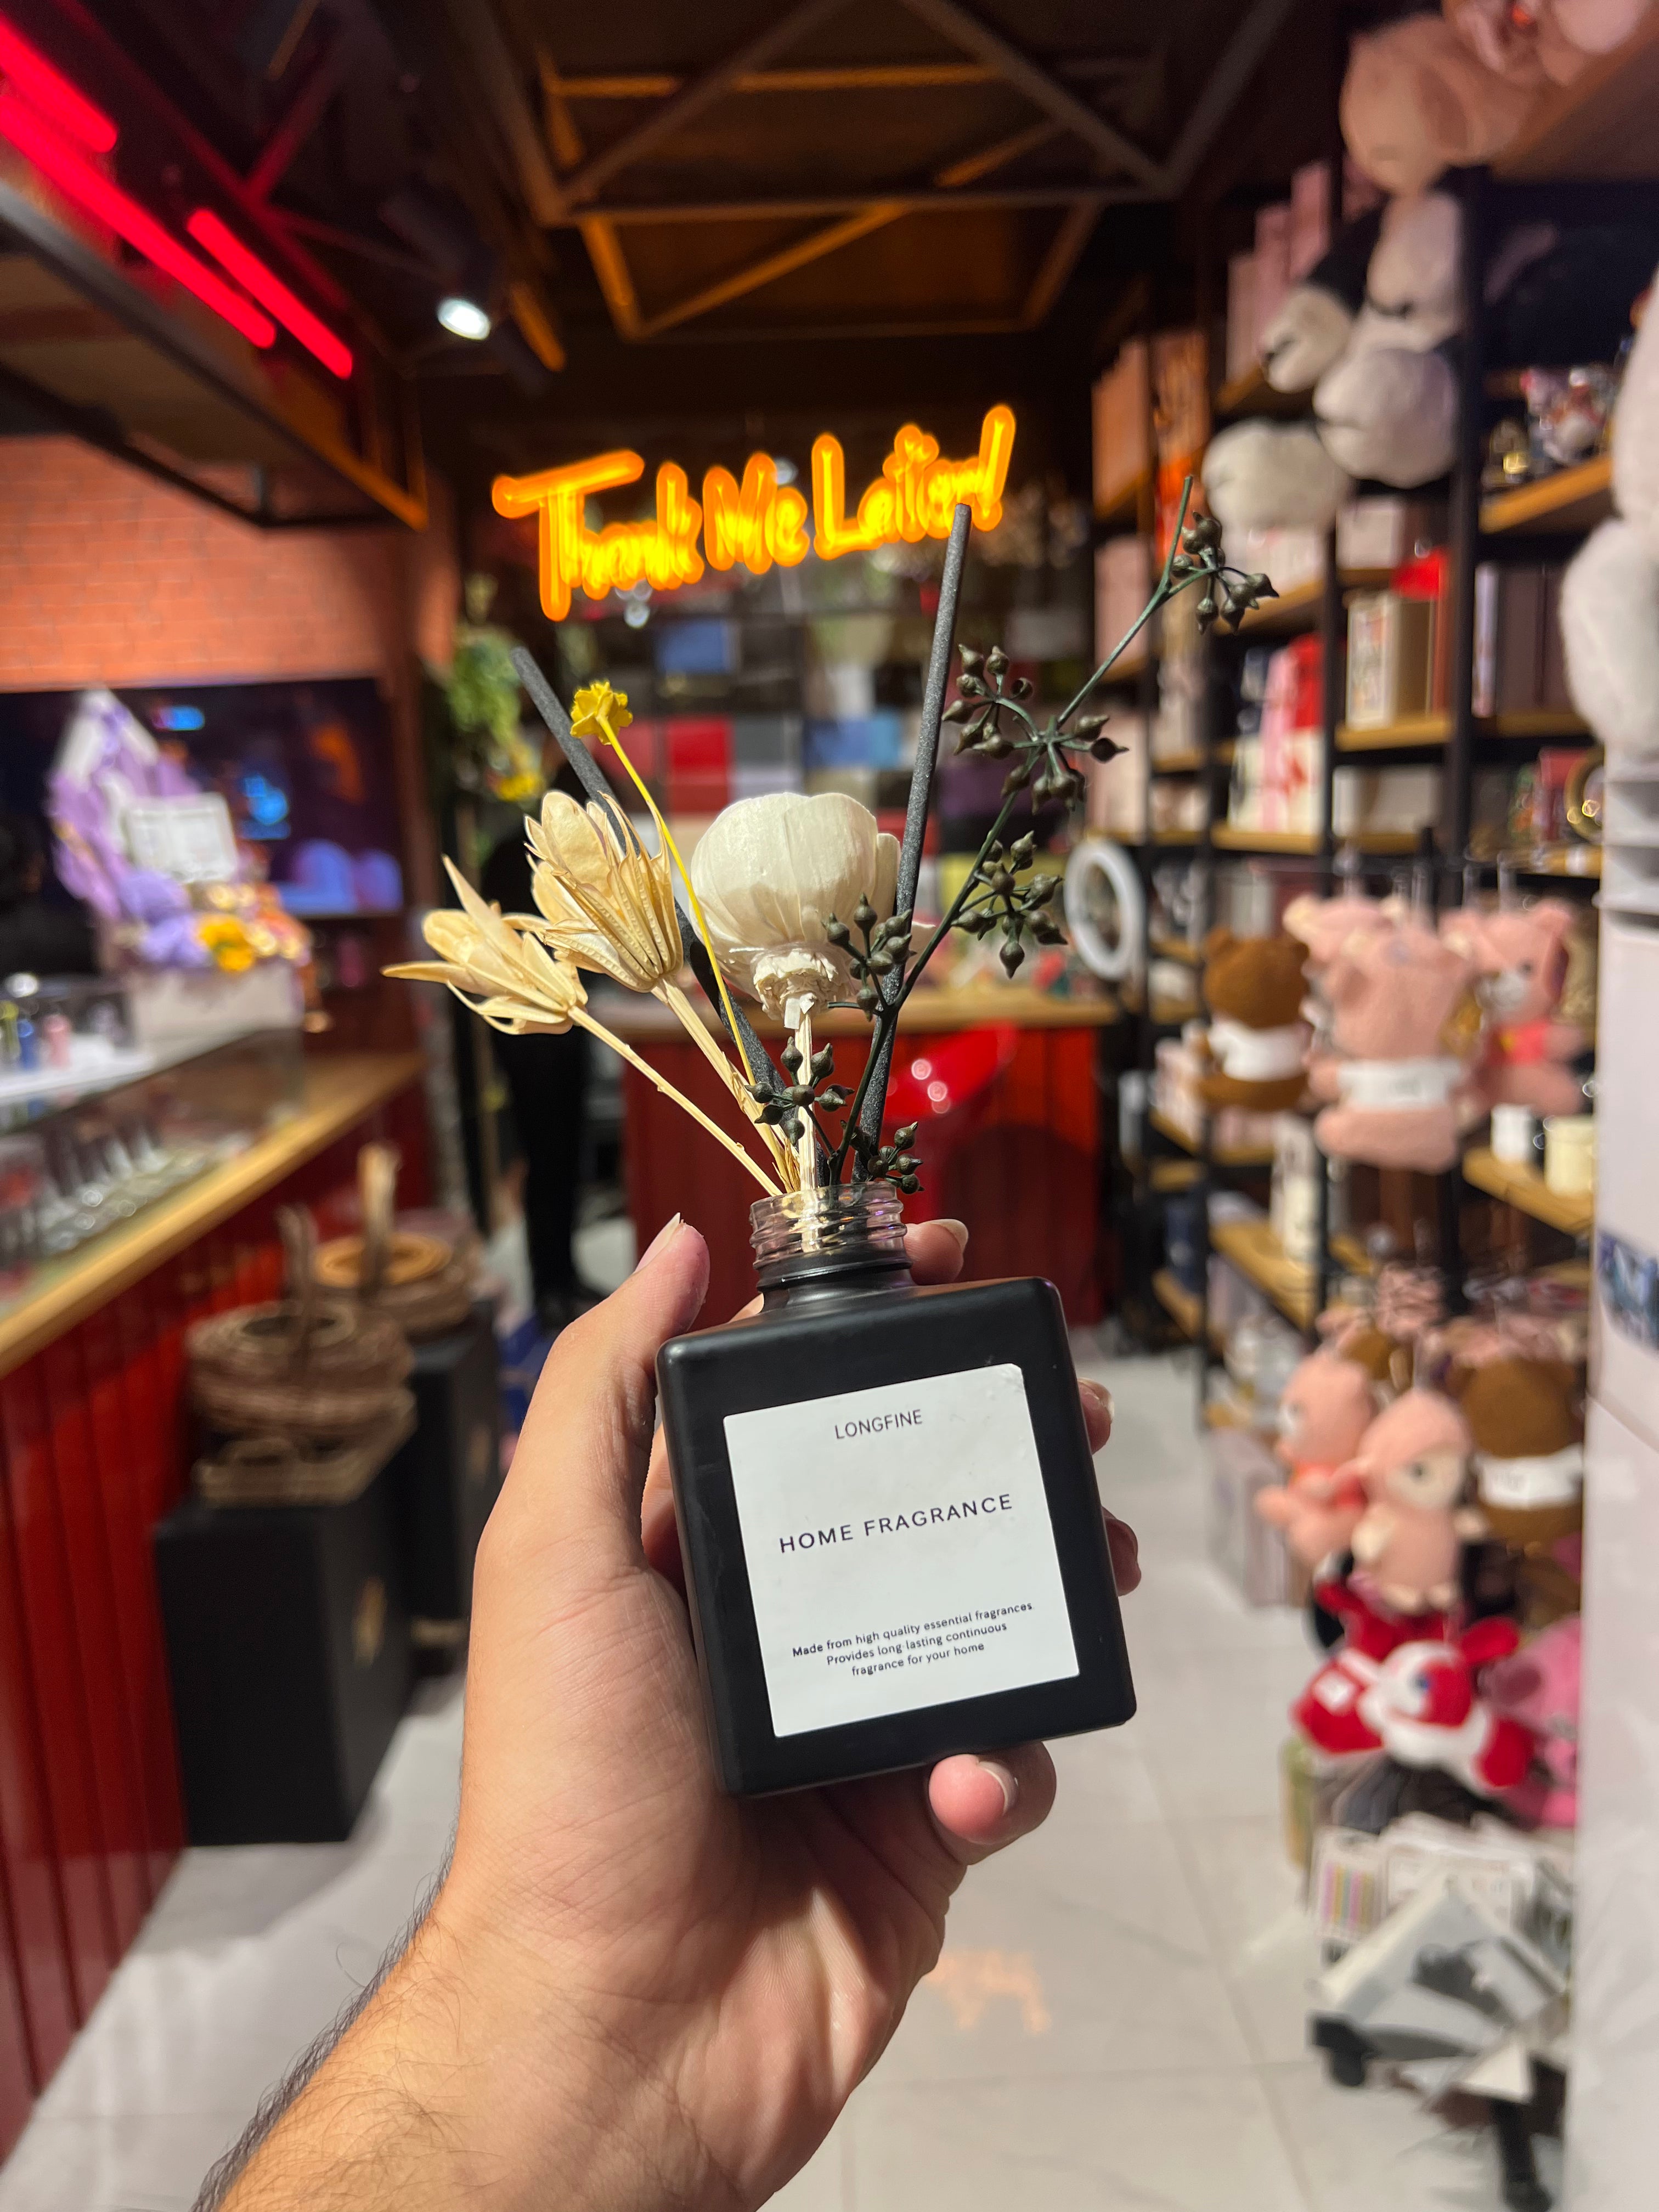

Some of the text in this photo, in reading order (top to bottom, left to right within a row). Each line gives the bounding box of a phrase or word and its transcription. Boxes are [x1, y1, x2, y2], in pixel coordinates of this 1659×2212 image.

[703, 452, 809, 574] Me
[834, 1409, 923, 1440] LONGFINE
[779, 1493, 1013, 1554] HOME FRAGRANCE
[792, 1602, 1032, 1658] Made from high quality essential fragrances
[826, 1623, 1008, 1666] Provides long lasting continuous
[851, 1643, 985, 1677] fragrance for your home
